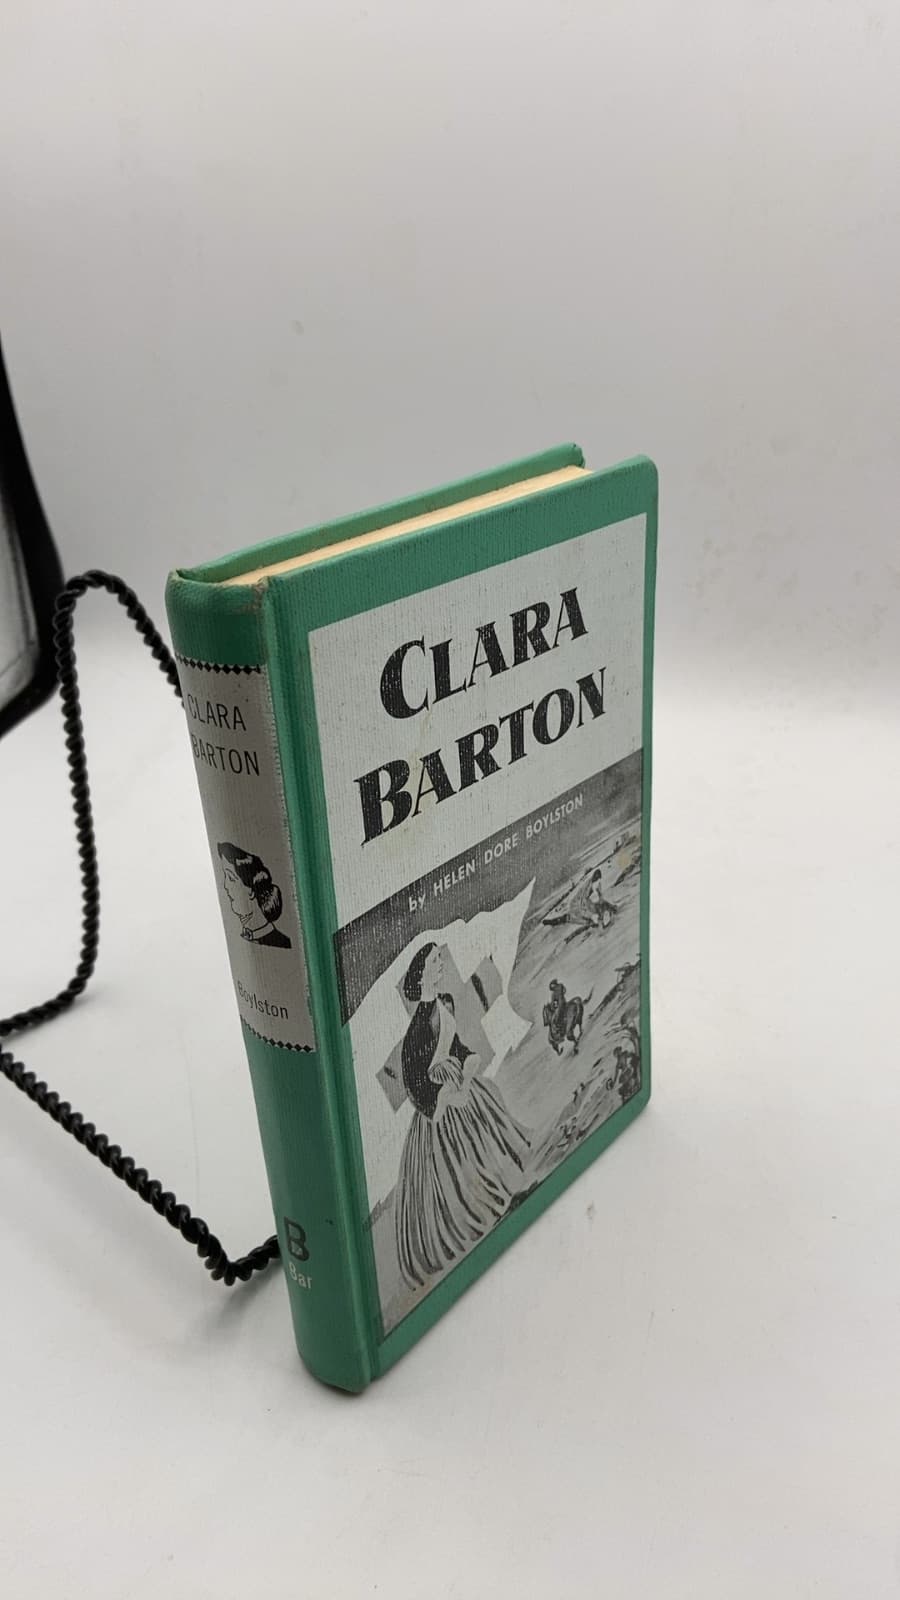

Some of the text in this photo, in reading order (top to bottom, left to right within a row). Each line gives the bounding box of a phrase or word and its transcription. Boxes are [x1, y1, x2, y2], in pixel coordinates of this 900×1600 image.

[379, 586, 589, 720] CLARA
[188, 694, 247, 732] CLARA
[191, 734, 261, 777] BARTON
[353, 666, 607, 847] BARTON
[408, 793, 584, 913] by HELEN DORE BOYLSTON
[237, 980, 289, 1020] Boylston
[283, 1215, 310, 1262] B
[288, 1261, 313, 1290] Bar
